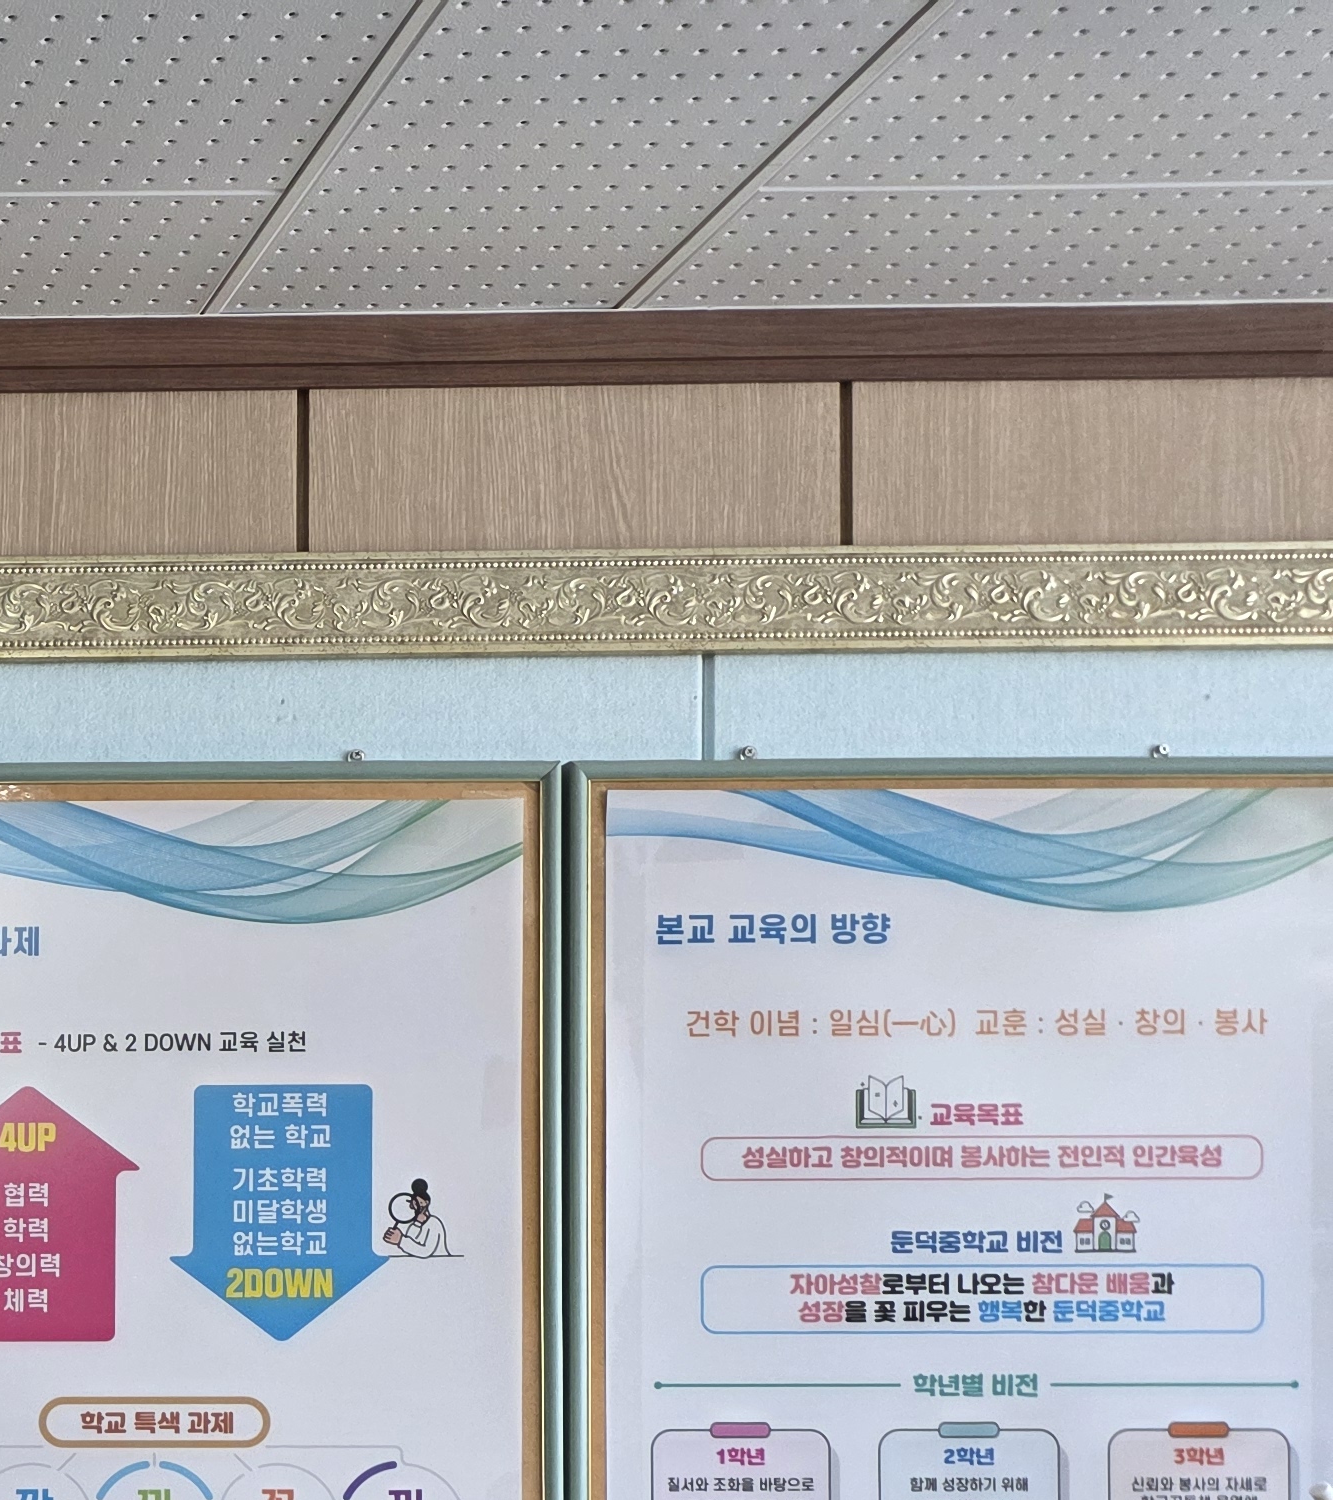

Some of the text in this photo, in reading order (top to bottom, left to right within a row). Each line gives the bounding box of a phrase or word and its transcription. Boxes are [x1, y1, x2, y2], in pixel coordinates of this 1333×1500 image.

[656, 913, 890, 945] 본교 교육의 방향
[687, 1010, 739, 1037] 건학
[750, 1010, 799, 1037] 이념
[976, 1008, 1027, 1036] 교훈
[1055, 1009, 1105, 1037] 성실
[1135, 1008, 1185, 1036] 창의
[1215, 1008, 1268, 1036] 봉사
[54, 1034, 96, 1052] 4UP
[103, 1034, 118, 1052] &
[125, 1031, 137, 1054] 2
[145, 1033, 211, 1051] DOWN
[219, 1032, 258, 1052] 교육
[267, 1031, 306, 1052] 실천
[233, 1093, 326, 1117] 학교폭력
[930, 1103, 1024, 1126] 교육목표
[230, 1124, 331, 1149] 없는 학교
[742, 1145, 1222, 1169] 성실하고 창의적이며 봉사하는 전인적 인간육성
[233, 1167, 326, 1192] 기초학력
[4, 1183, 48, 1207] 협력
[234, 1199, 326, 1224] 미달학생
[4, 1217, 48, 1242] 학력
[891, 1230, 1062, 1253] 둔덕중학교 비전
[233, 1230, 326, 1256] 없는학교
[226, 1268, 333, 1298] 2DOWN
[791, 1272, 1175, 1295] 자아성찰로부터 나오는 참다운 배움과
[4, 1288, 48, 1312] 체력
[799, 1301, 867, 1323] 성장을
[903, 1301, 970, 1322] 피우는
[978, 1300, 1047, 1322] 행복한
[1053, 1300, 1165, 1322] 둔덕중학교
[913, 1373, 1038, 1397] 학년별 비전
[81, 1411, 233, 1434] 학교 특색 과제
[717, 1448, 765, 1466] 1학년
[944, 1447, 994, 1465] 2학년
[1174, 1447, 1224, 1465] 3학년
[942, 1477, 996, 1492] 성장하기
